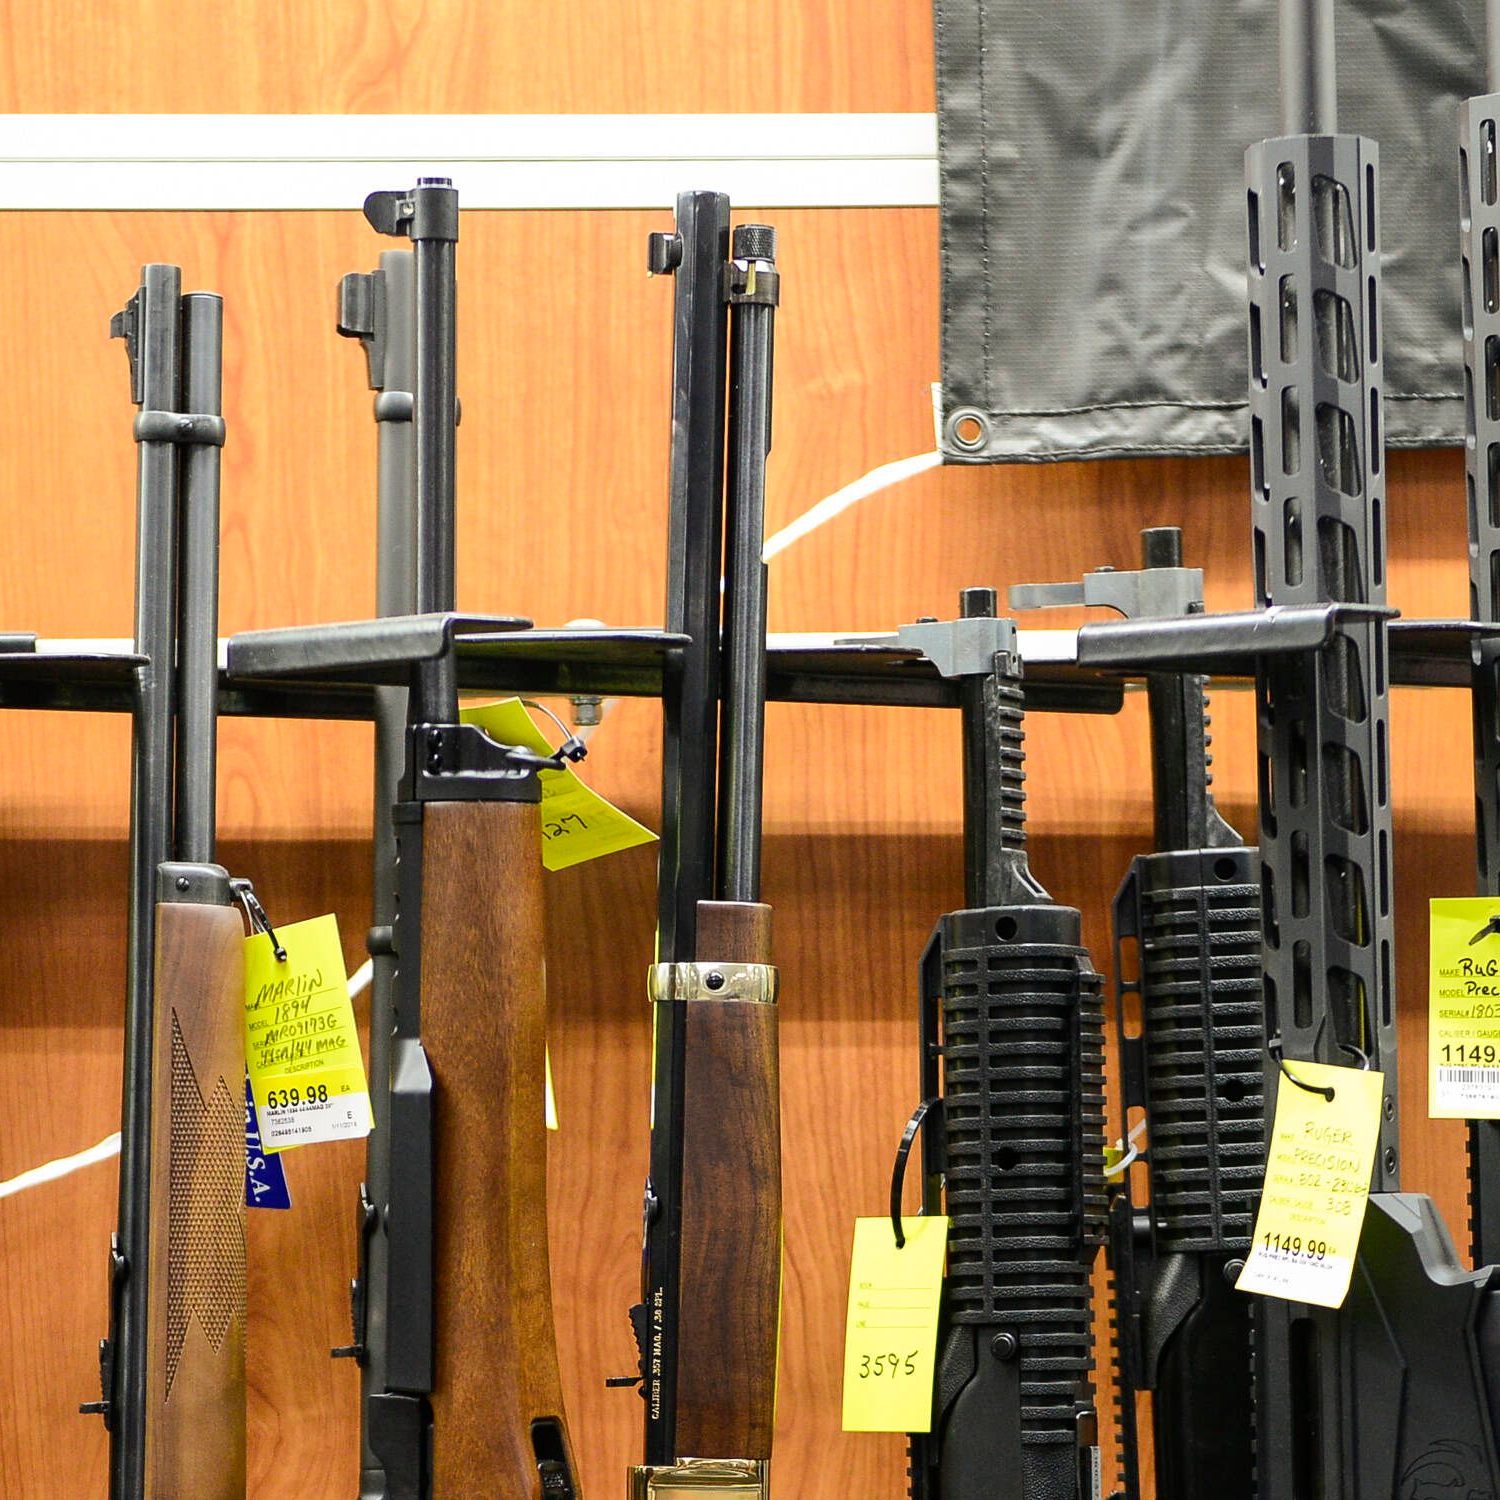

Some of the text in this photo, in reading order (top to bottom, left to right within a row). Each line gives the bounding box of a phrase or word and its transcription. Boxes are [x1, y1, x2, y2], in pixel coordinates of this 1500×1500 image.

[274, 995, 311, 1024] 1894
[249, 1019, 269, 1030] MODEL
[285, 1058, 324, 1074] DESCRIPTION
[268, 1084, 328, 1109] 639.98
[1264, 1232, 1327, 1260] 1149.99
[860, 1350, 918, 1379] 3595
